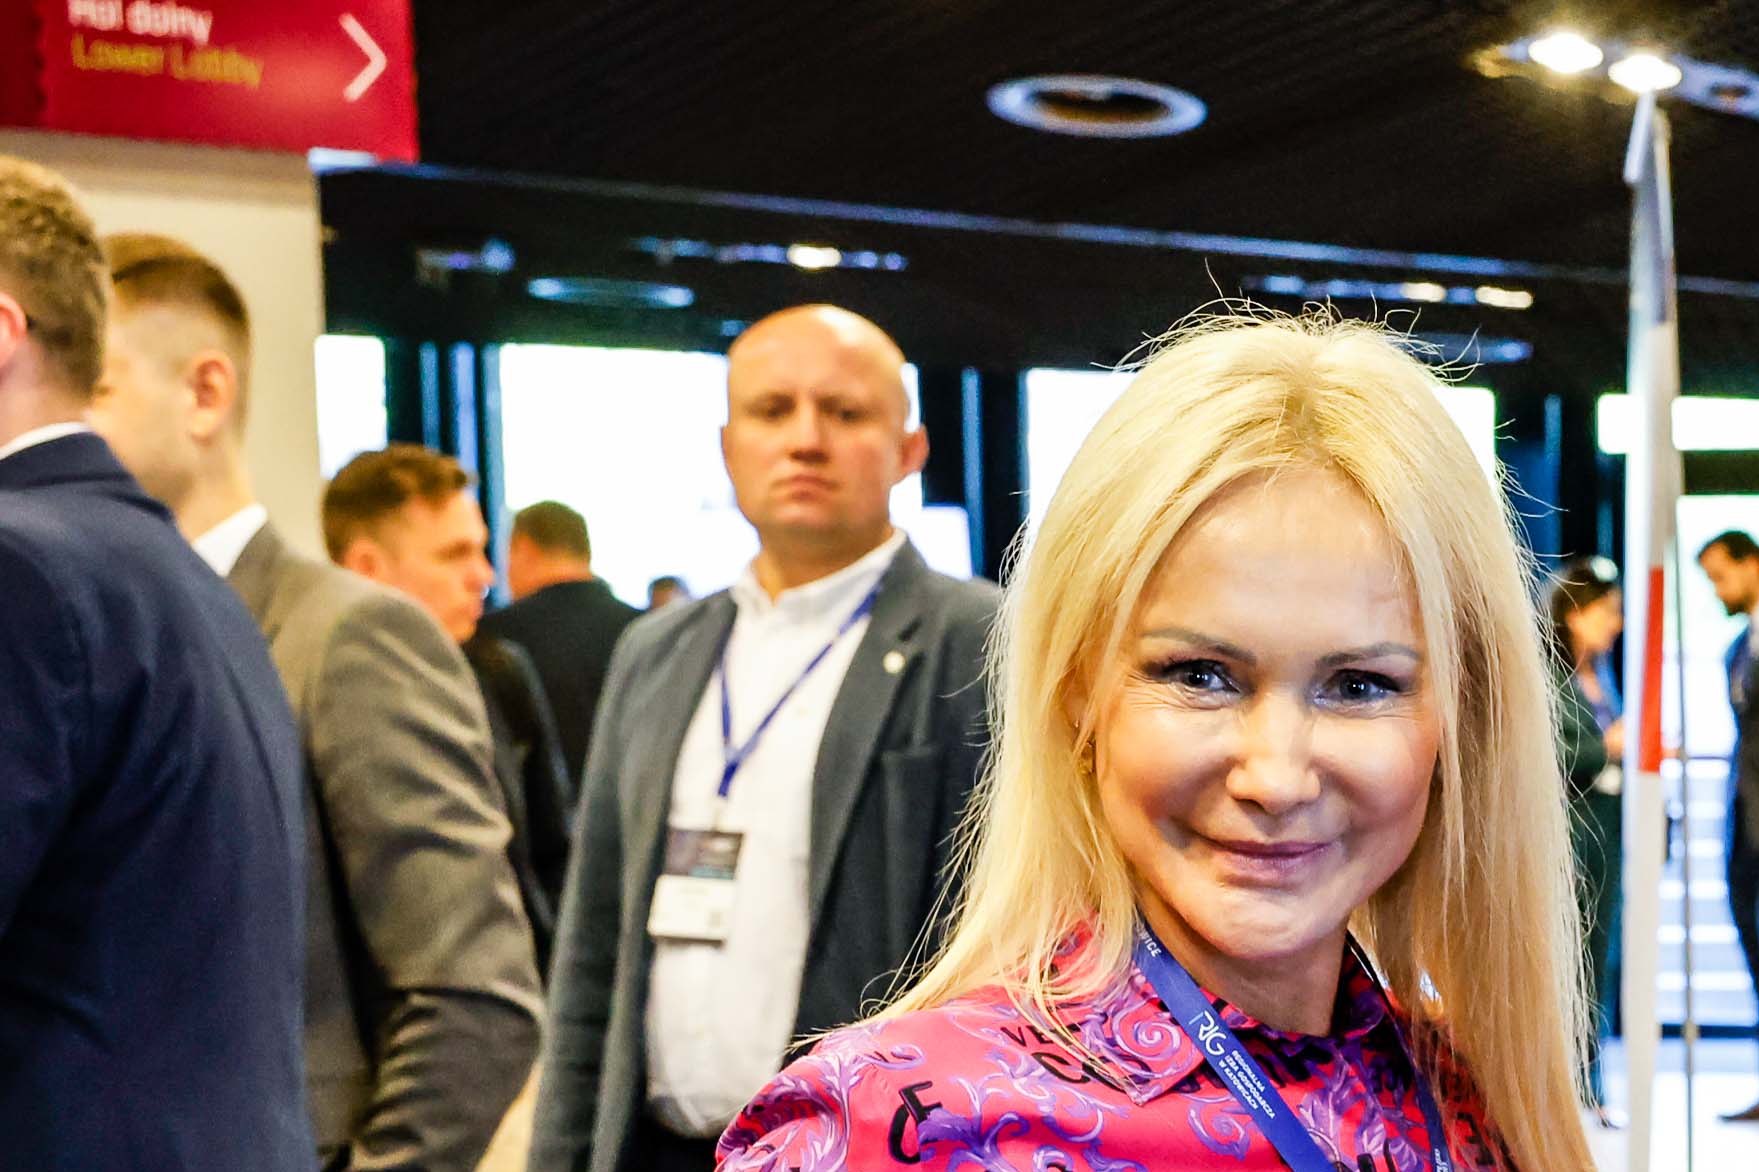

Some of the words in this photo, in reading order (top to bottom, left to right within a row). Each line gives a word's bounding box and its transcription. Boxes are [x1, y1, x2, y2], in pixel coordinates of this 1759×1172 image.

[70, 32, 165, 75] Lower
[169, 43, 264, 89] Lobby
[1224, 1055, 1239, 1073] IZBA
[1237, 1070, 1276, 1119] GOSPODARCZA
[1224, 1068, 1259, 1110] KATOWICACH
[1230, 1050, 1265, 1092] REGIONALNA
